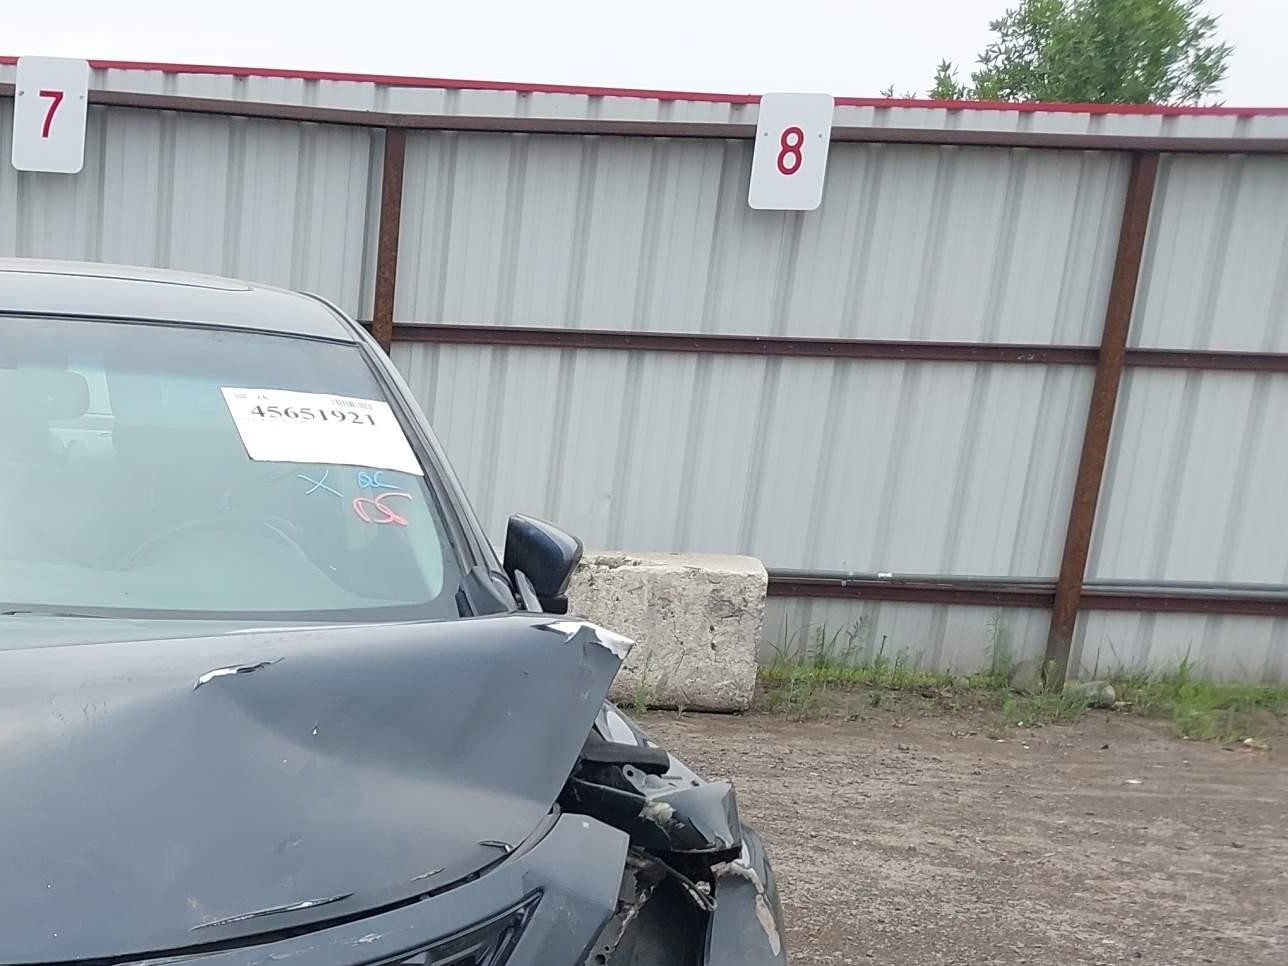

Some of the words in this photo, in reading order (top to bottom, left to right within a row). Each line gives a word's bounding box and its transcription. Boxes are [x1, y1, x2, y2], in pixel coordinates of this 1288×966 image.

[39, 90, 64, 138] 7
[777, 126, 805, 176] 8
[250, 405, 376, 426] 45651921
